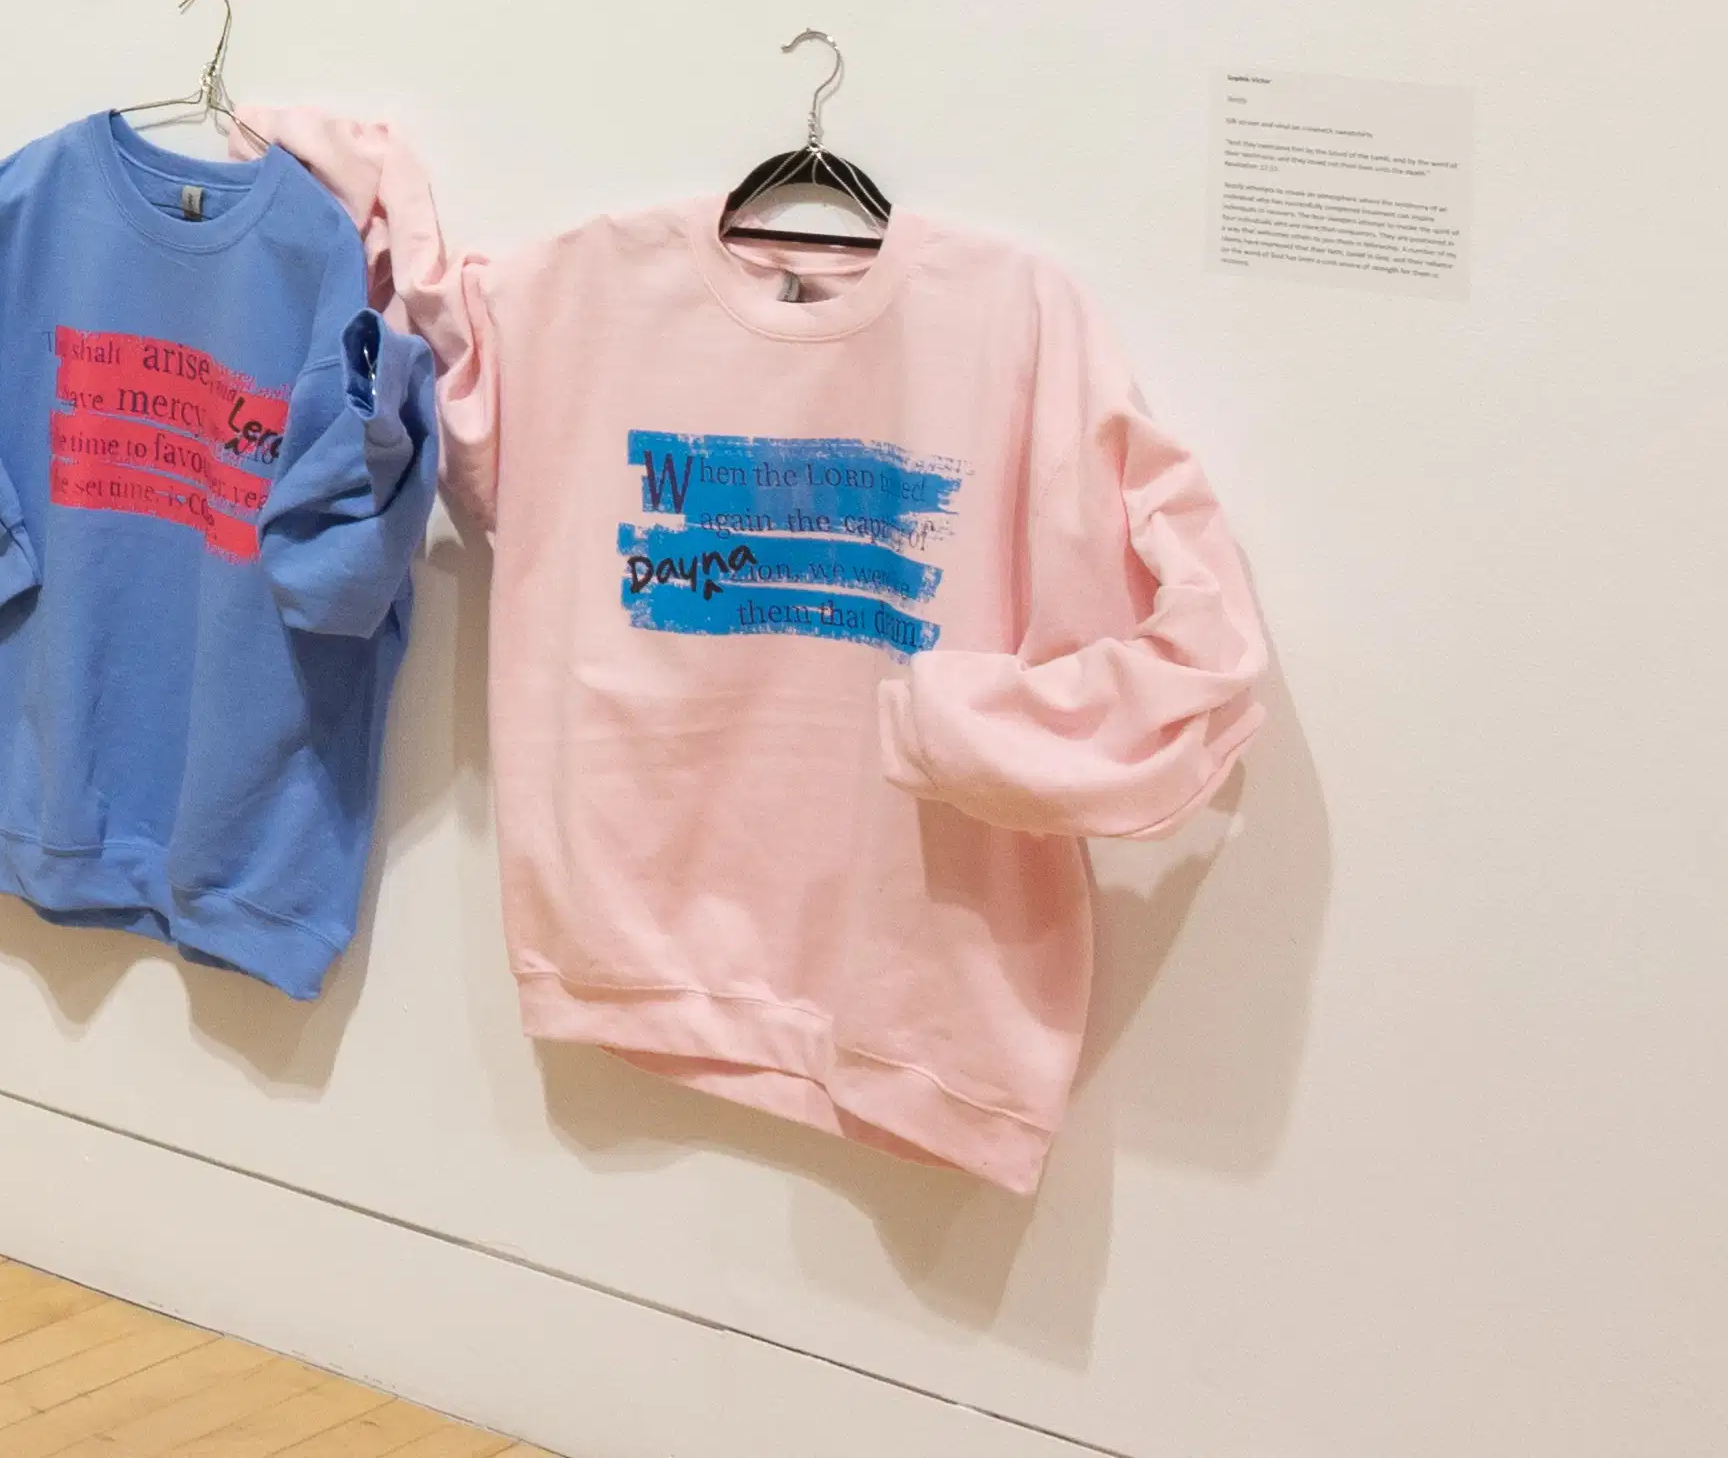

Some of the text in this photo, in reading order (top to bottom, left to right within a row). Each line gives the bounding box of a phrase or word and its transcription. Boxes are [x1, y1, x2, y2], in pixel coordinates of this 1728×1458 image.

[117, 386, 207, 428] mercy
[126, 440, 147, 458] to
[753, 462, 797, 487] the
[807, 462, 875, 489] LORD
[700, 507, 772, 540] again
[787, 508, 830, 533] the
[627, 545, 758, 593] Dayna
[808, 560, 845, 581] we
[737, 599, 812, 626] them
[820, 600, 866, 630] that
